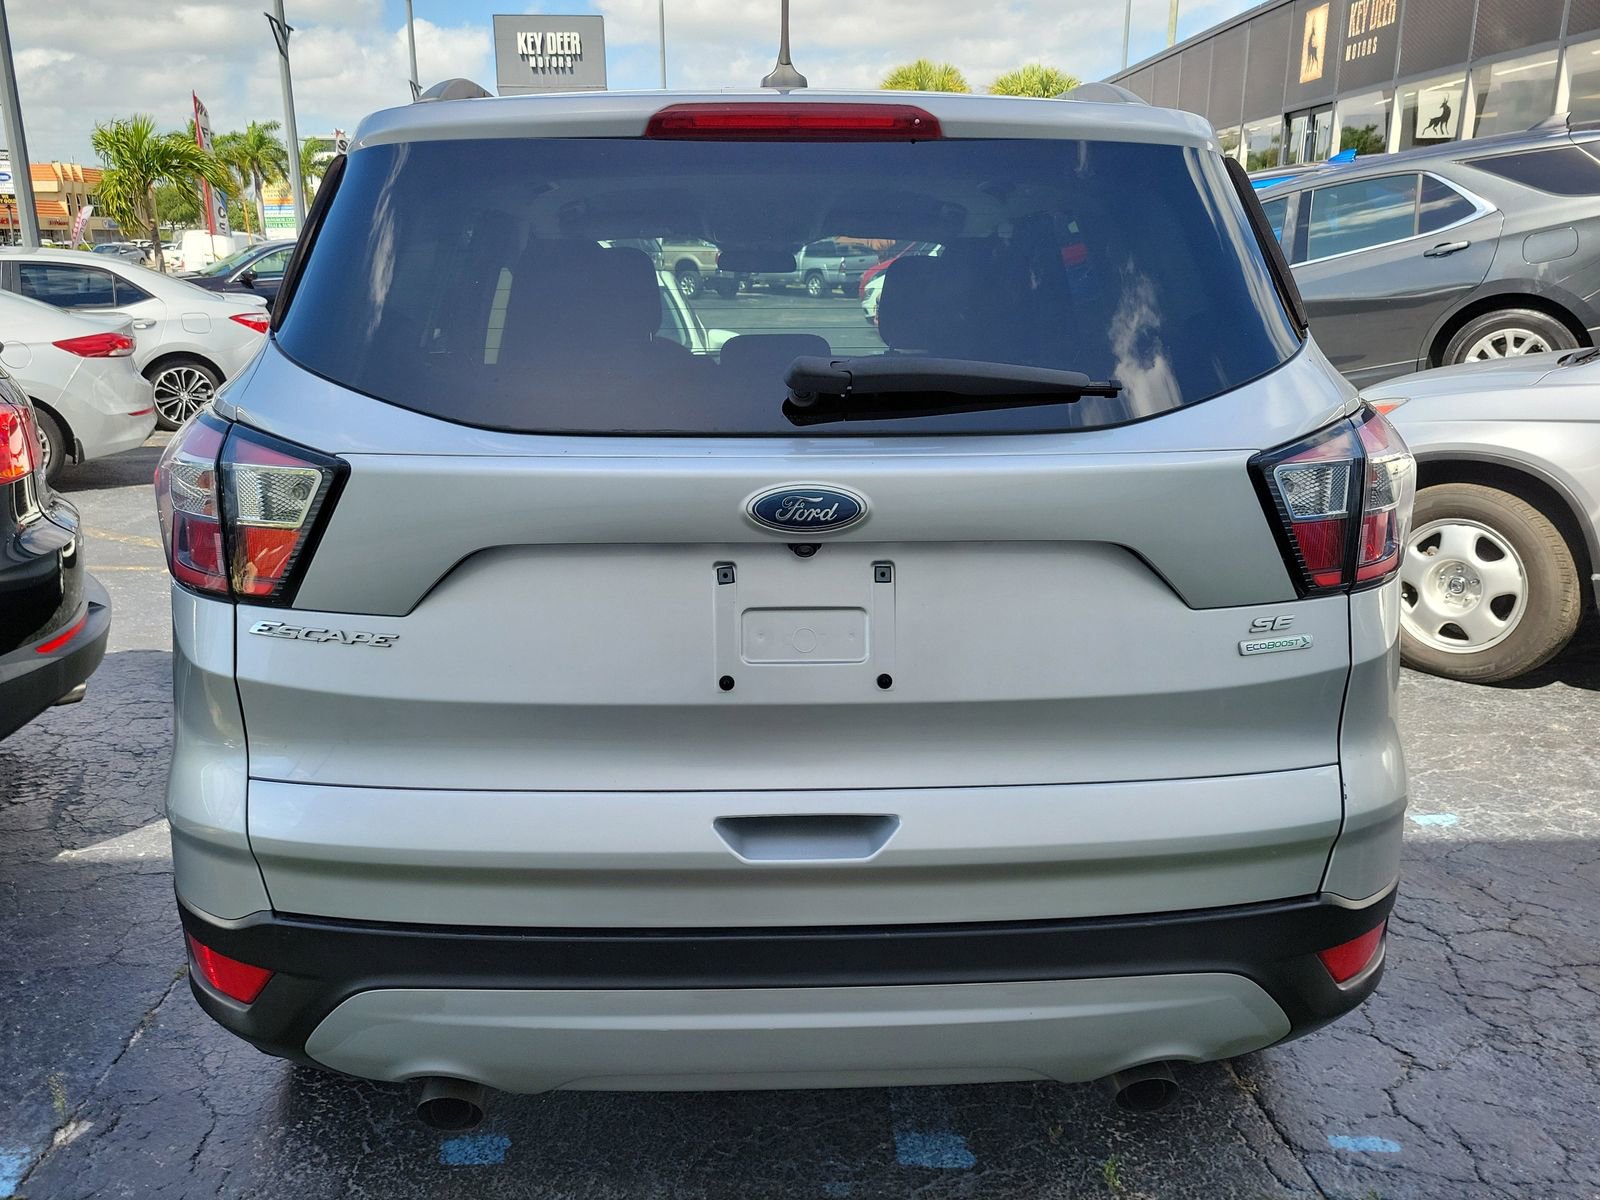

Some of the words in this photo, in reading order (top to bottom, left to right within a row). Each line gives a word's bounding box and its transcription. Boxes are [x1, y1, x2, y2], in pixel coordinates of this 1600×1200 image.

[1348, 0, 1370, 38] KEY
[517, 32, 543, 55] KEY
[546, 32, 582, 55] DEER
[1345, 36, 1378, 62] MOTORS
[529, 56, 573, 68] MOTORS
[775, 495, 839, 521] Ford
[249, 620, 400, 648] ESCAPE
[1249, 614, 1297, 633] SE
